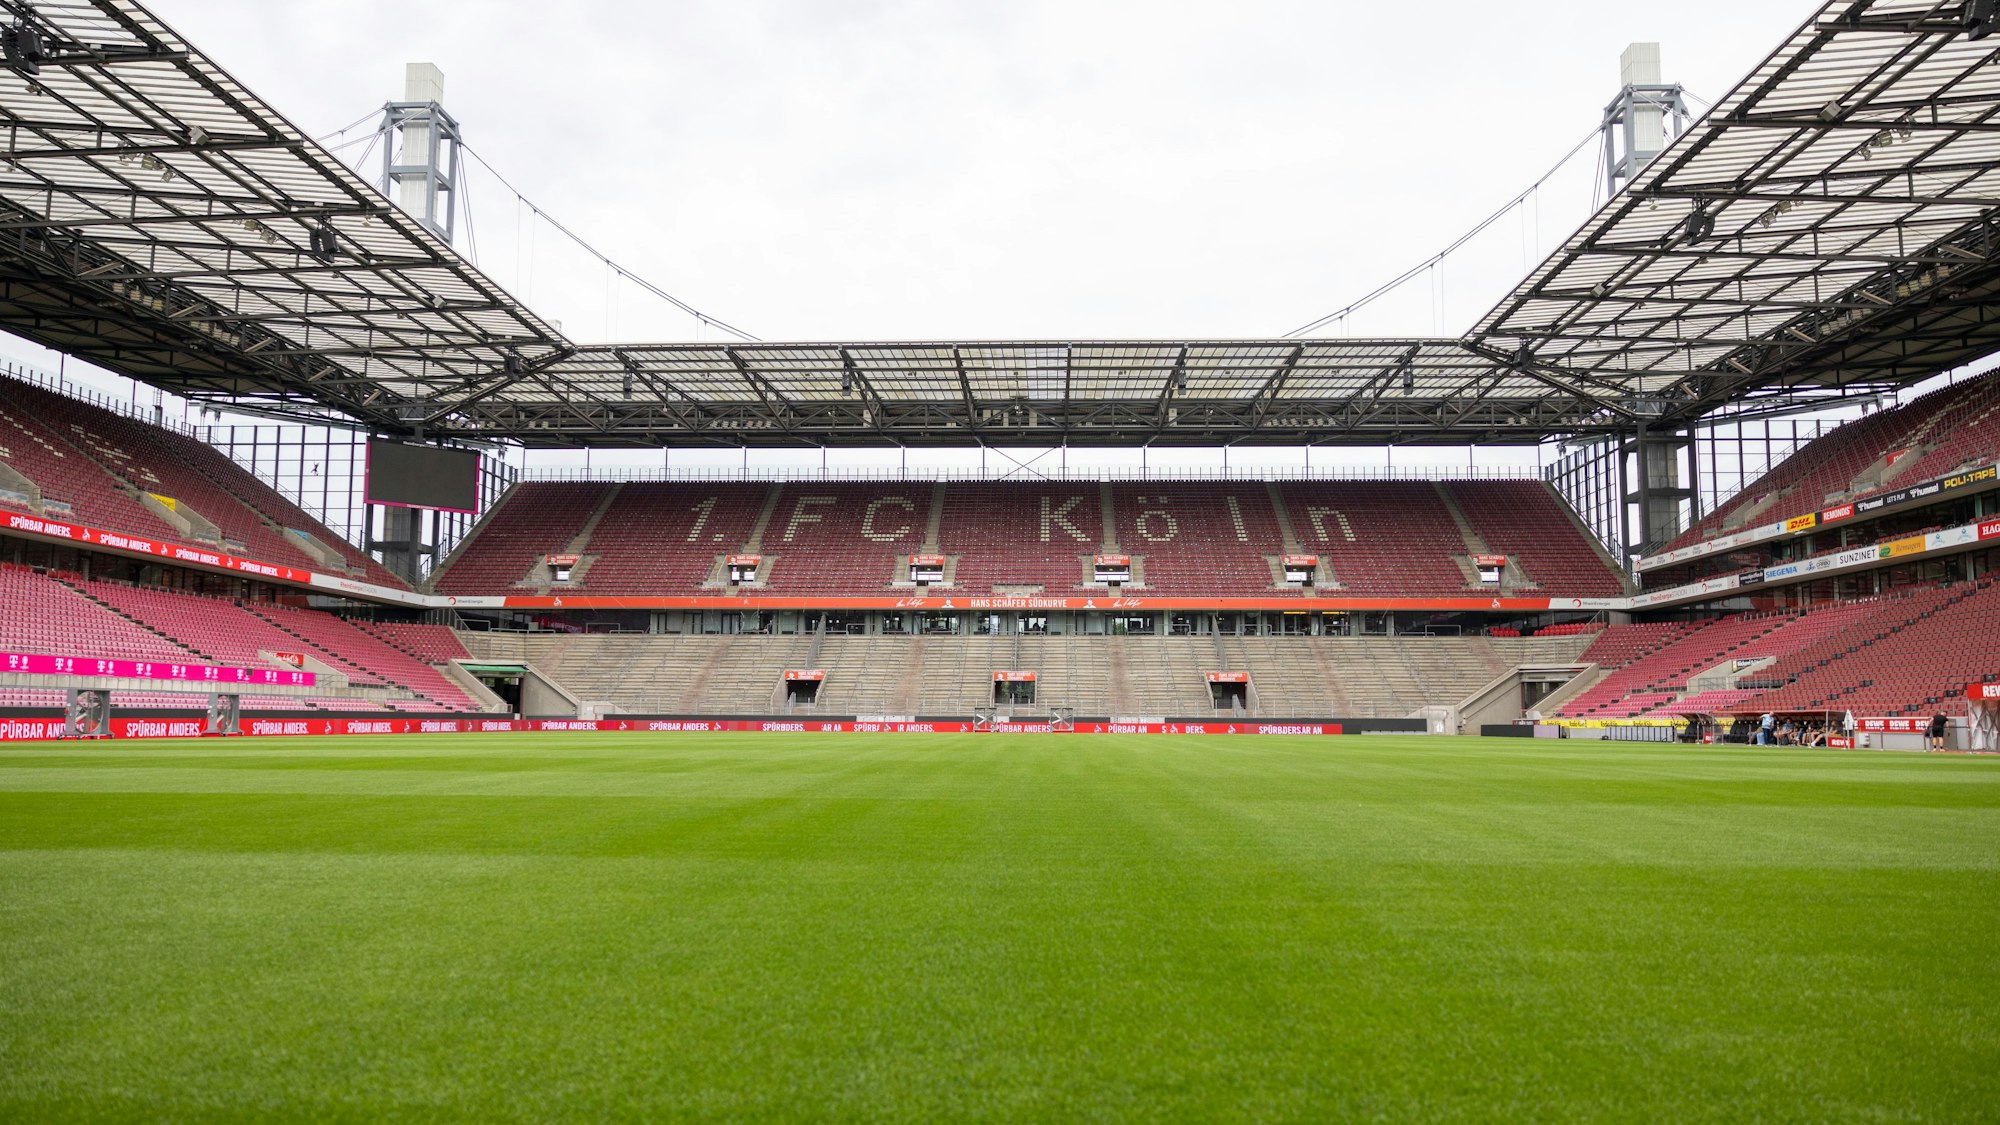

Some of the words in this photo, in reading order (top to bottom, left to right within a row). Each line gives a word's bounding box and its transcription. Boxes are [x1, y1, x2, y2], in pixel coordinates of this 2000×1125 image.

[1917, 483, 1939, 496] hummel
[10, 516, 43, 532] SPÜRBAR
[44, 523, 72, 538] ANDERS.
[1790, 517, 1811, 529] DHL
[100, 534, 128, 548] SPÜRBAR
[128, 540, 152, 553] ANDERS.
[176, 549, 200, 561] SPÜRBAR
[1840, 549, 1875, 564] SUNZINET
[240, 561, 261, 573] SPÜRBAR
[1766, 566, 1797, 578] SIEGENIA
[971, 599, 990, 607] HANS
[992, 598, 1026, 607] SCHÄFER
[1029, 598, 1067, 607] SÜDKURVE
[126, 720, 167, 737] SPÜRBAR
[252, 720, 282, 735] SPÜRBAR
[283, 722, 309, 734] ANDERS.
[347, 720, 372, 733] SPÜRBAR
[372, 722, 392, 733] ANDERS.
[568, 722, 598, 730] ANDERS.
[649, 721, 681, 731] SPÜRBAR
[682, 722, 709, 731] ANDERS
[906, 724, 935, 732] ANDERS.
[1865, 720, 1884, 730] REWE
[1889, 720, 1909, 730] REWE
